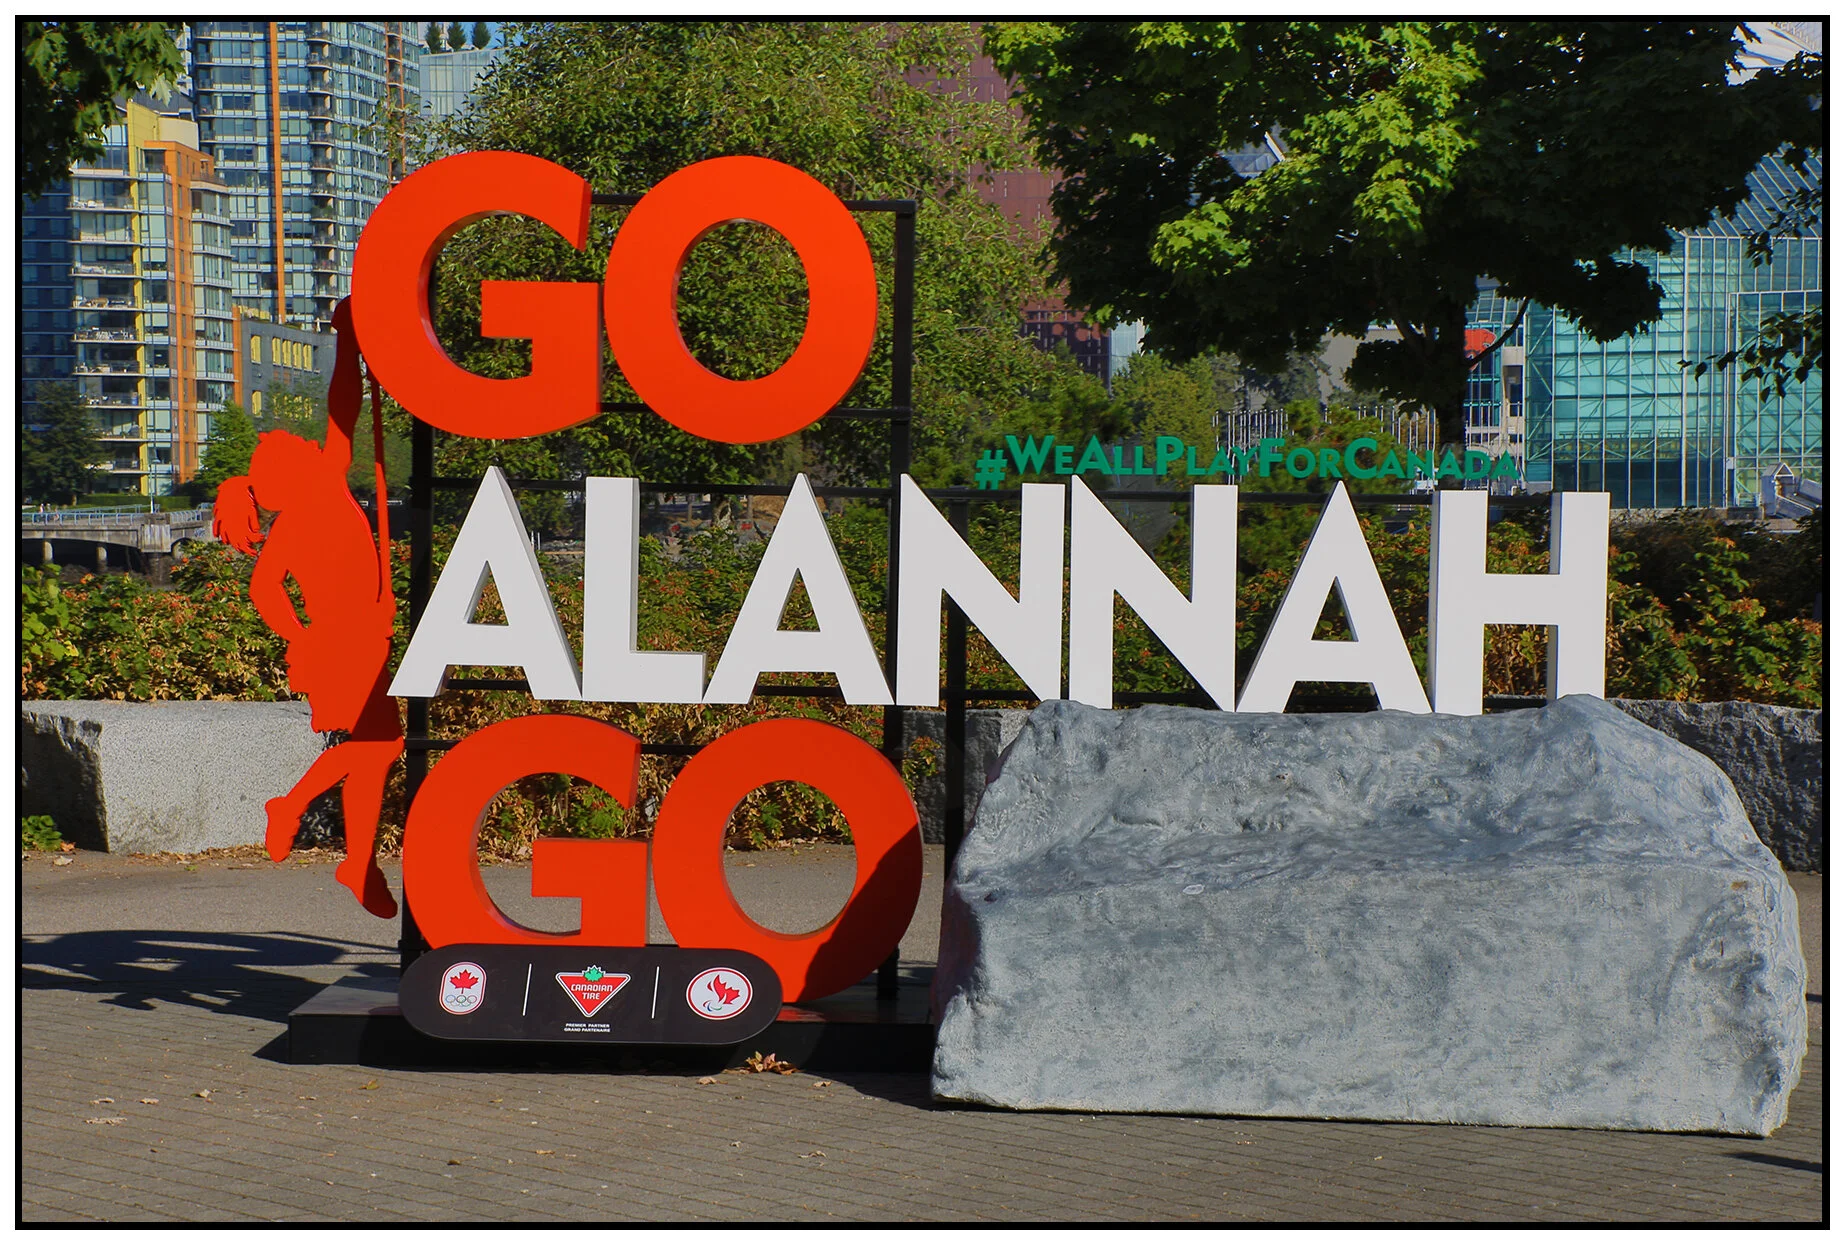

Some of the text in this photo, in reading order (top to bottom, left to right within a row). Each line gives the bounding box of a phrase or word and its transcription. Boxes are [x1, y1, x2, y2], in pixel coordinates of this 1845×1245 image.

[352, 149, 878, 444] GO
[388, 466, 1610, 714] ALANNAH
[403, 714, 923, 1003] GO
[571, 984, 613, 992] CANADIAN
